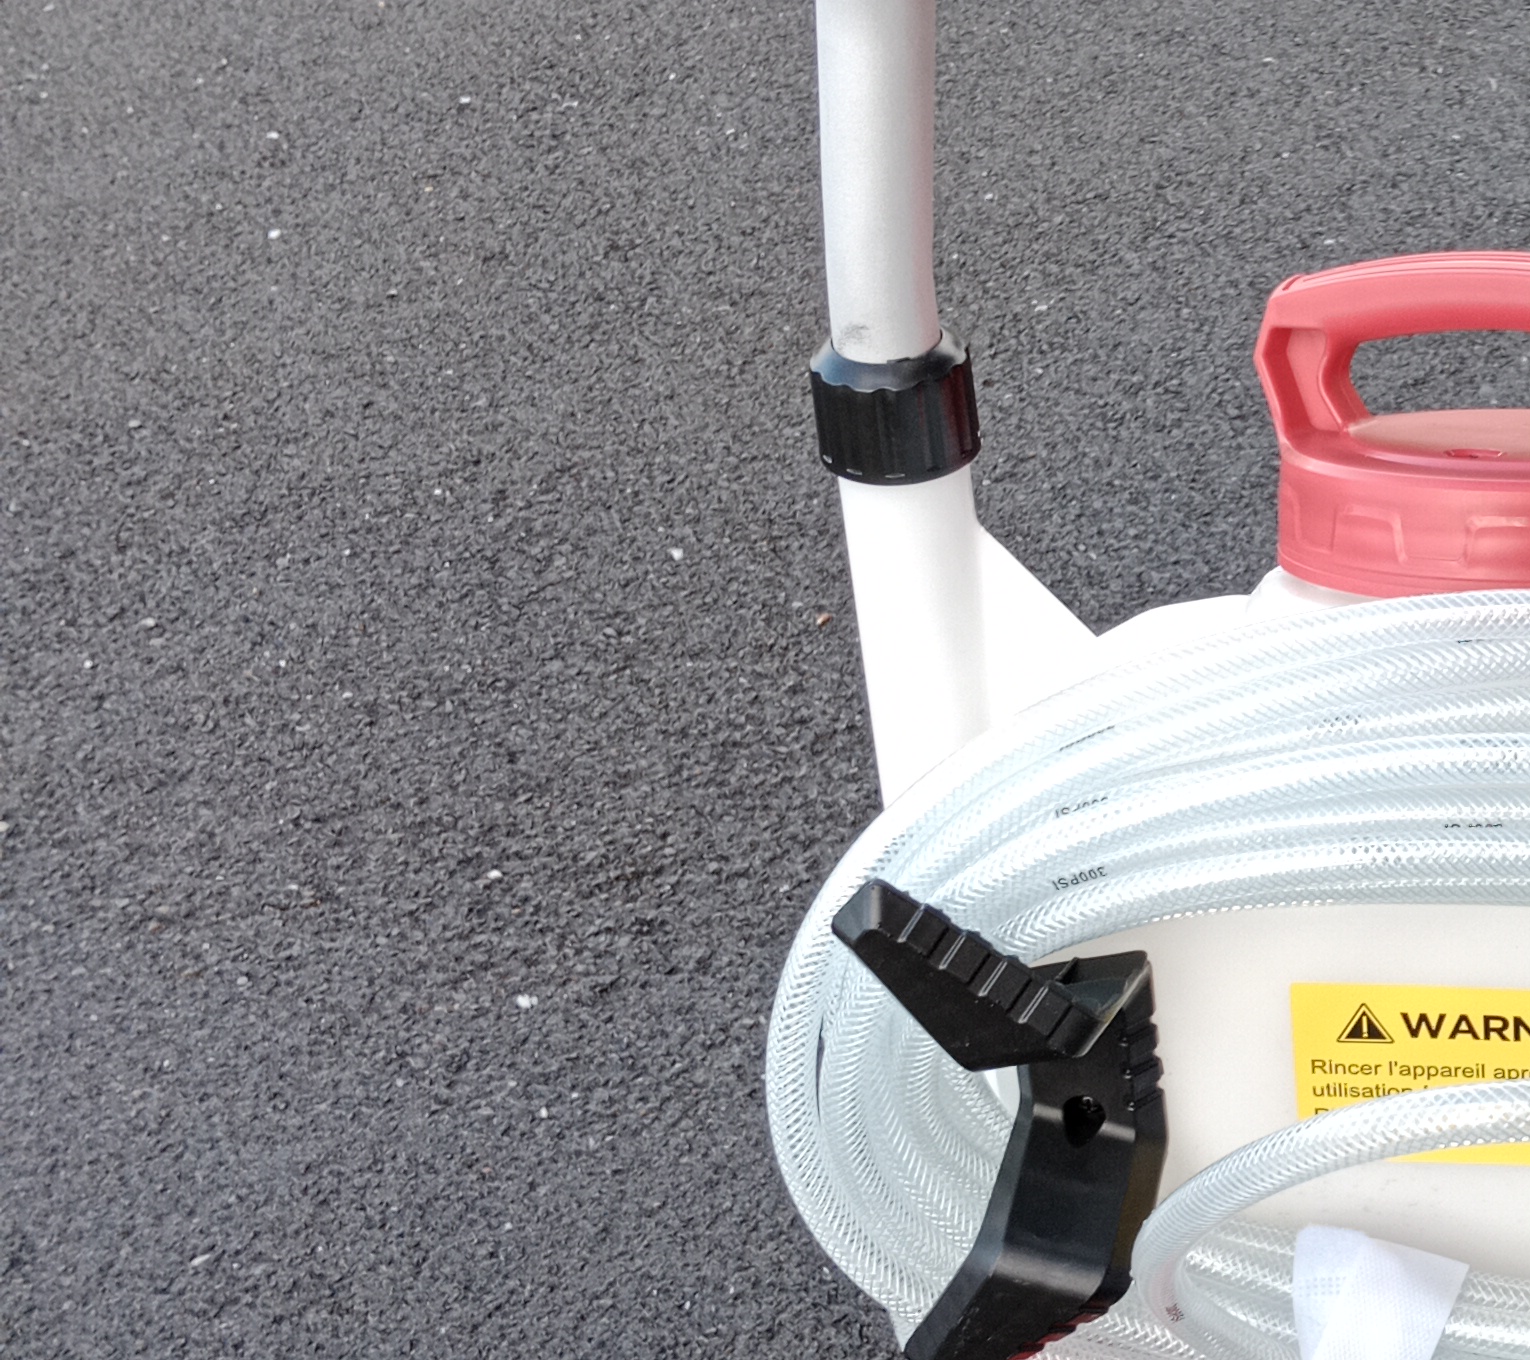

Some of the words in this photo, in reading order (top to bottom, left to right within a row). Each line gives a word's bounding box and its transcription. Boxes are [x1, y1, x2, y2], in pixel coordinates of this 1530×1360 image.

[1052, 866, 1107, 891] 300PSI
[1311, 1059, 1382, 1076] Rincer
[1389, 1060, 1486, 1080] l'appareil
